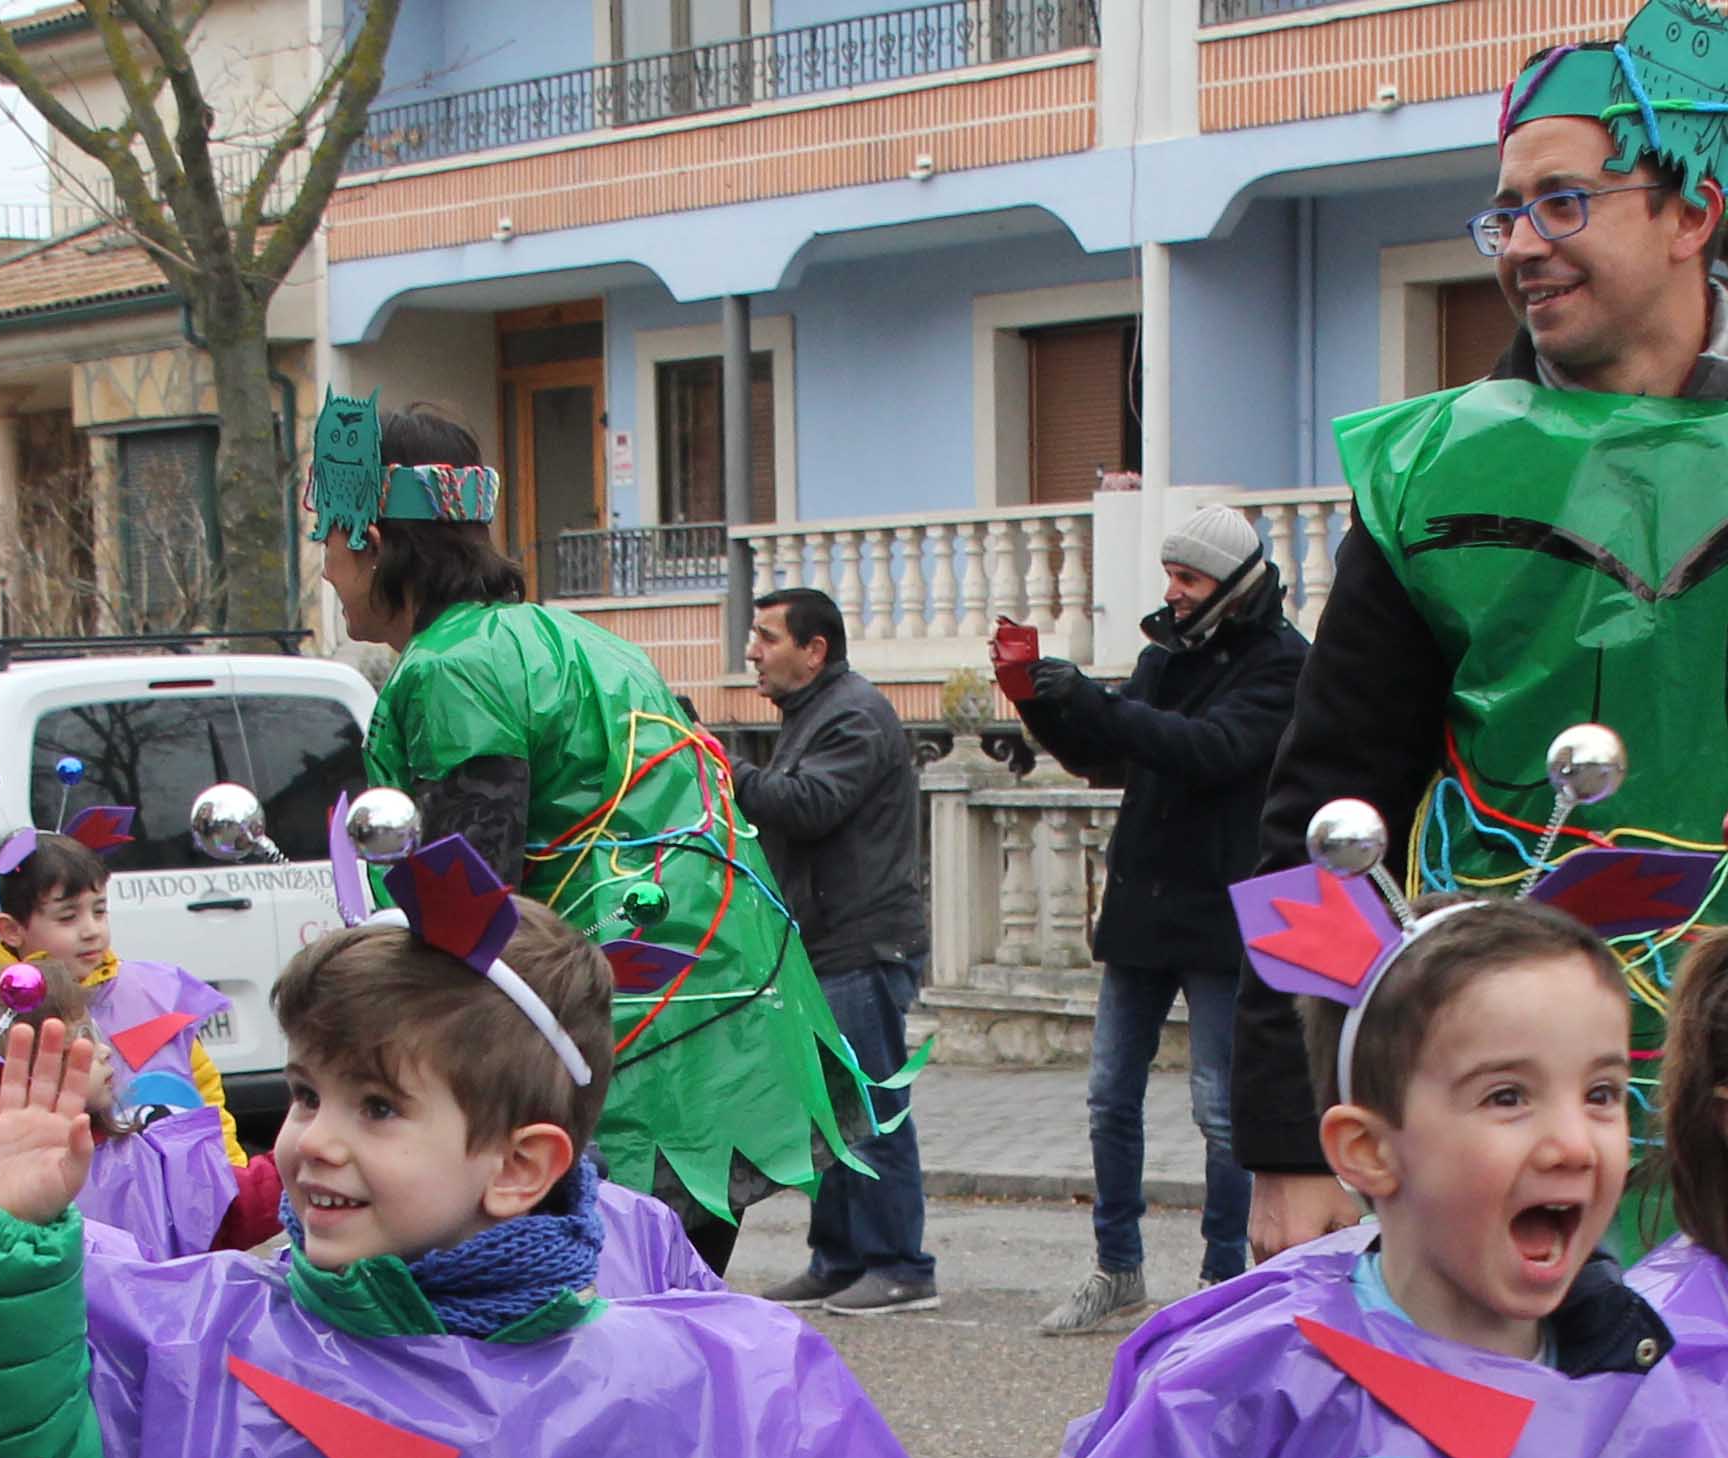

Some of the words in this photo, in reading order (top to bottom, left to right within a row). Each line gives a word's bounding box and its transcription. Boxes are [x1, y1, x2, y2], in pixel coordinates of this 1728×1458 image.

[116, 875, 197, 904] LIJADO
[203, 873, 217, 892] Y
[227, 867, 334, 892] BARNIZAD
